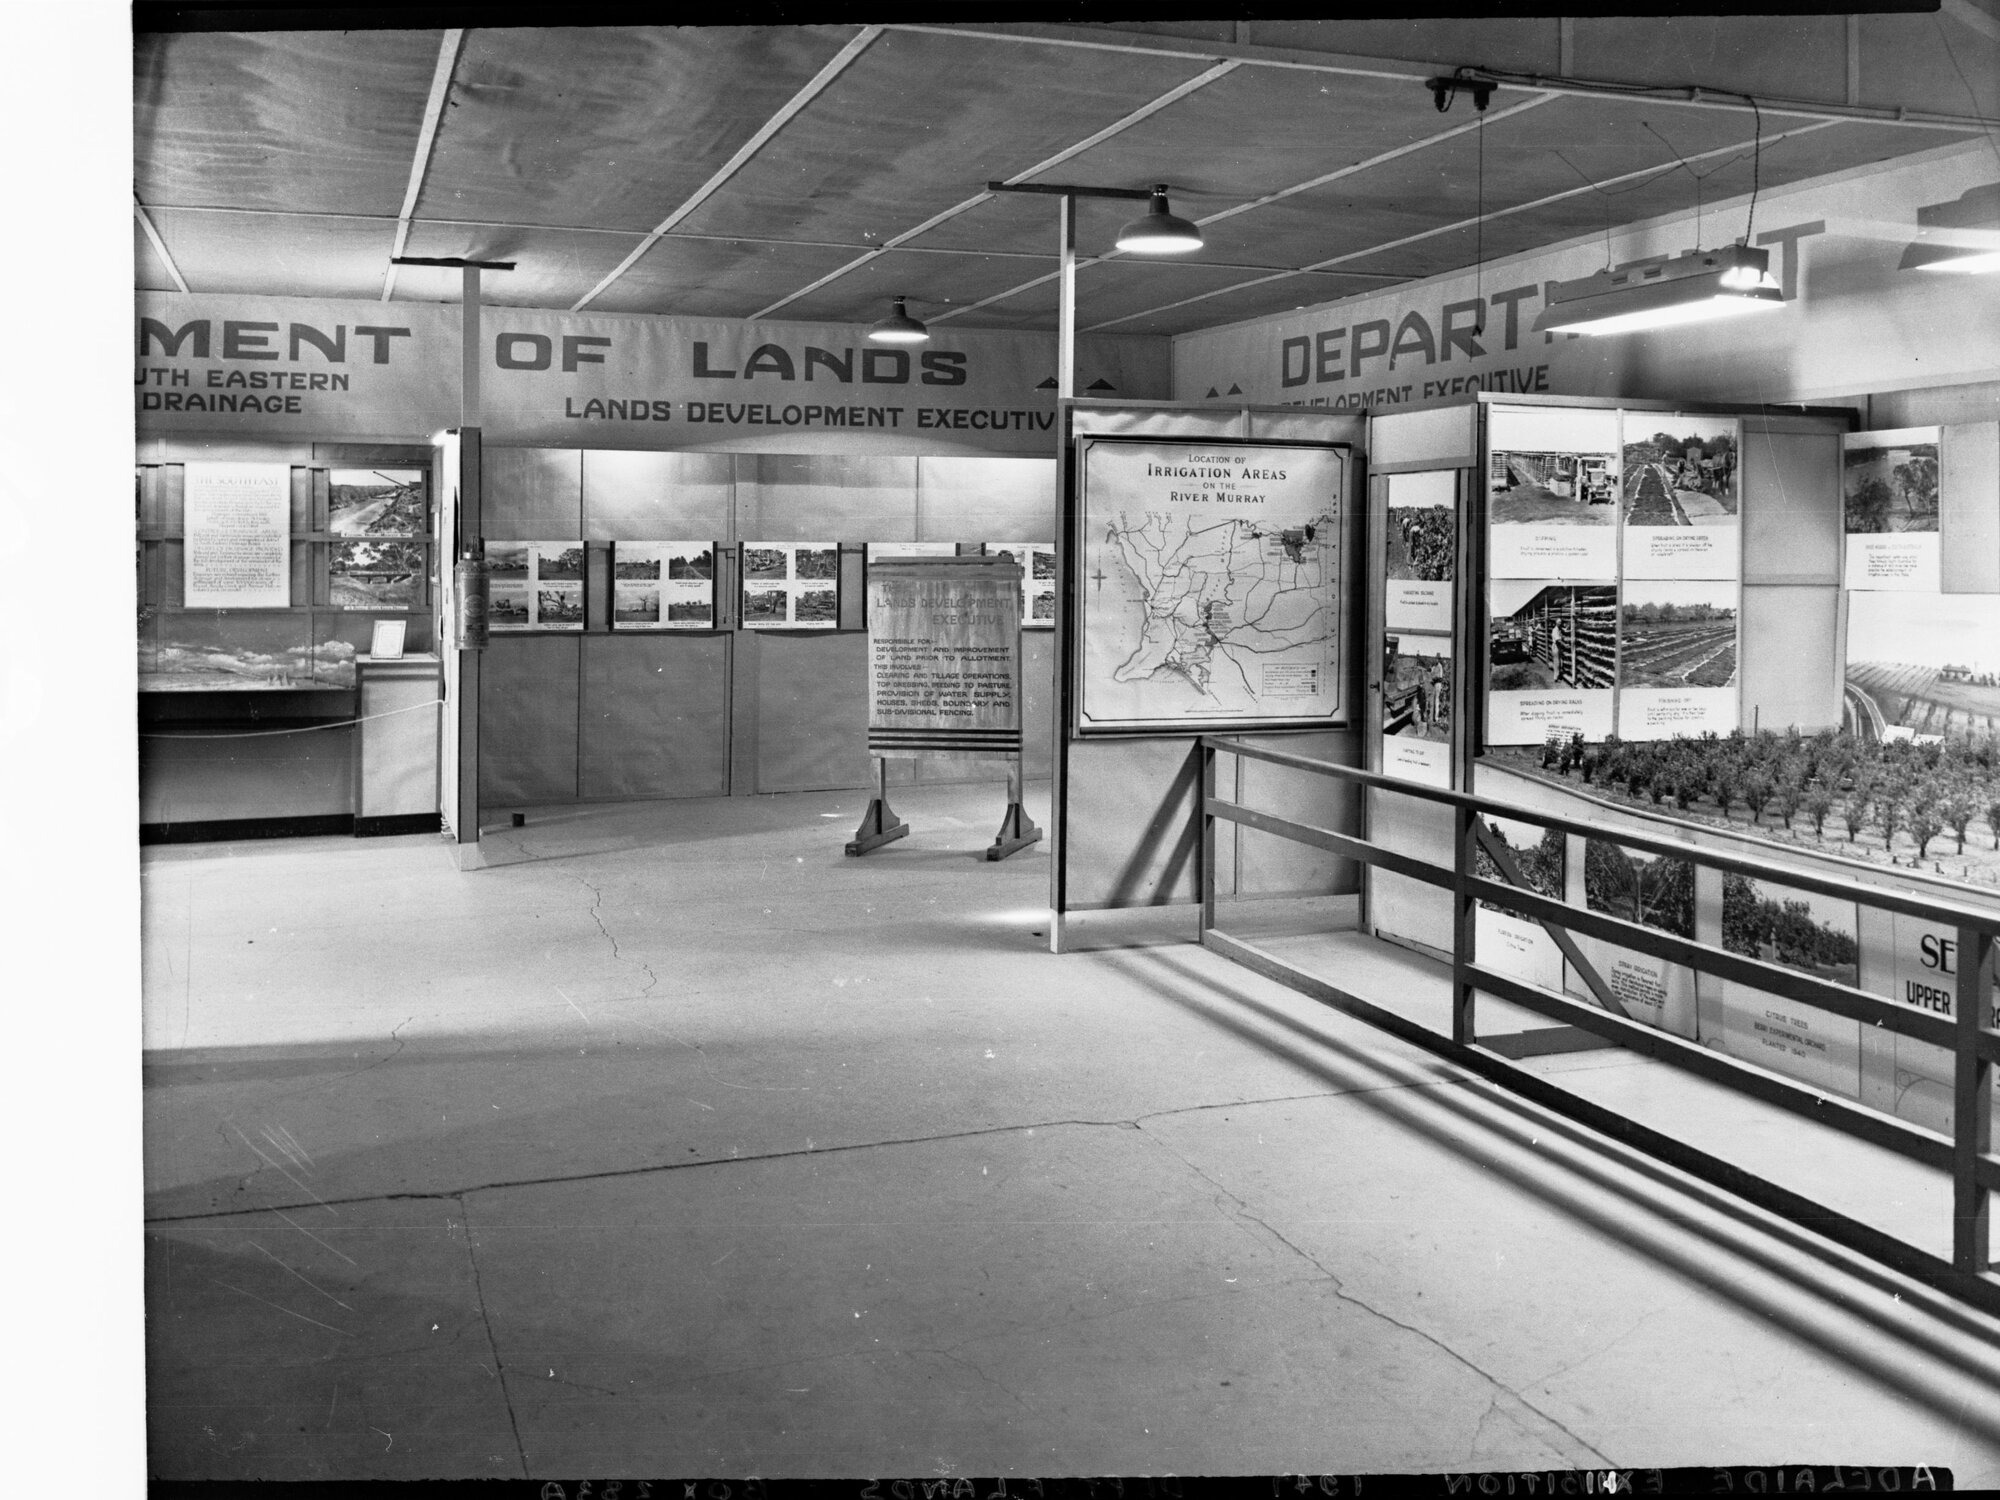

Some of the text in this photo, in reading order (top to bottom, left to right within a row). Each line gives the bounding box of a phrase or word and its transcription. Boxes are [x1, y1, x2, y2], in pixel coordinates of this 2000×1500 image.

[1281, 219, 1826, 388] DEPARTT
[140, 316, 968, 386] MENT OF LANDS
[207, 369, 349, 391] EASTERN
[1423, 364, 1550, 400] EXECUTIVE
[143, 392, 302, 413] DRAINAGE
[565, 397, 1055, 431] LANDS DEVELOPMENT EXECUTIV
[1188, 453, 1247, 465] LOCATION OF
[1147, 463, 1287, 481] IRRIGATION AREAS
[1202, 482, 1236, 491] ON THE
[1170, 491, 1266, 505] RIVER MURRAY
[931, 672, 960, 680] TILLAGE
[1906, 980, 1951, 1016] UPPER
